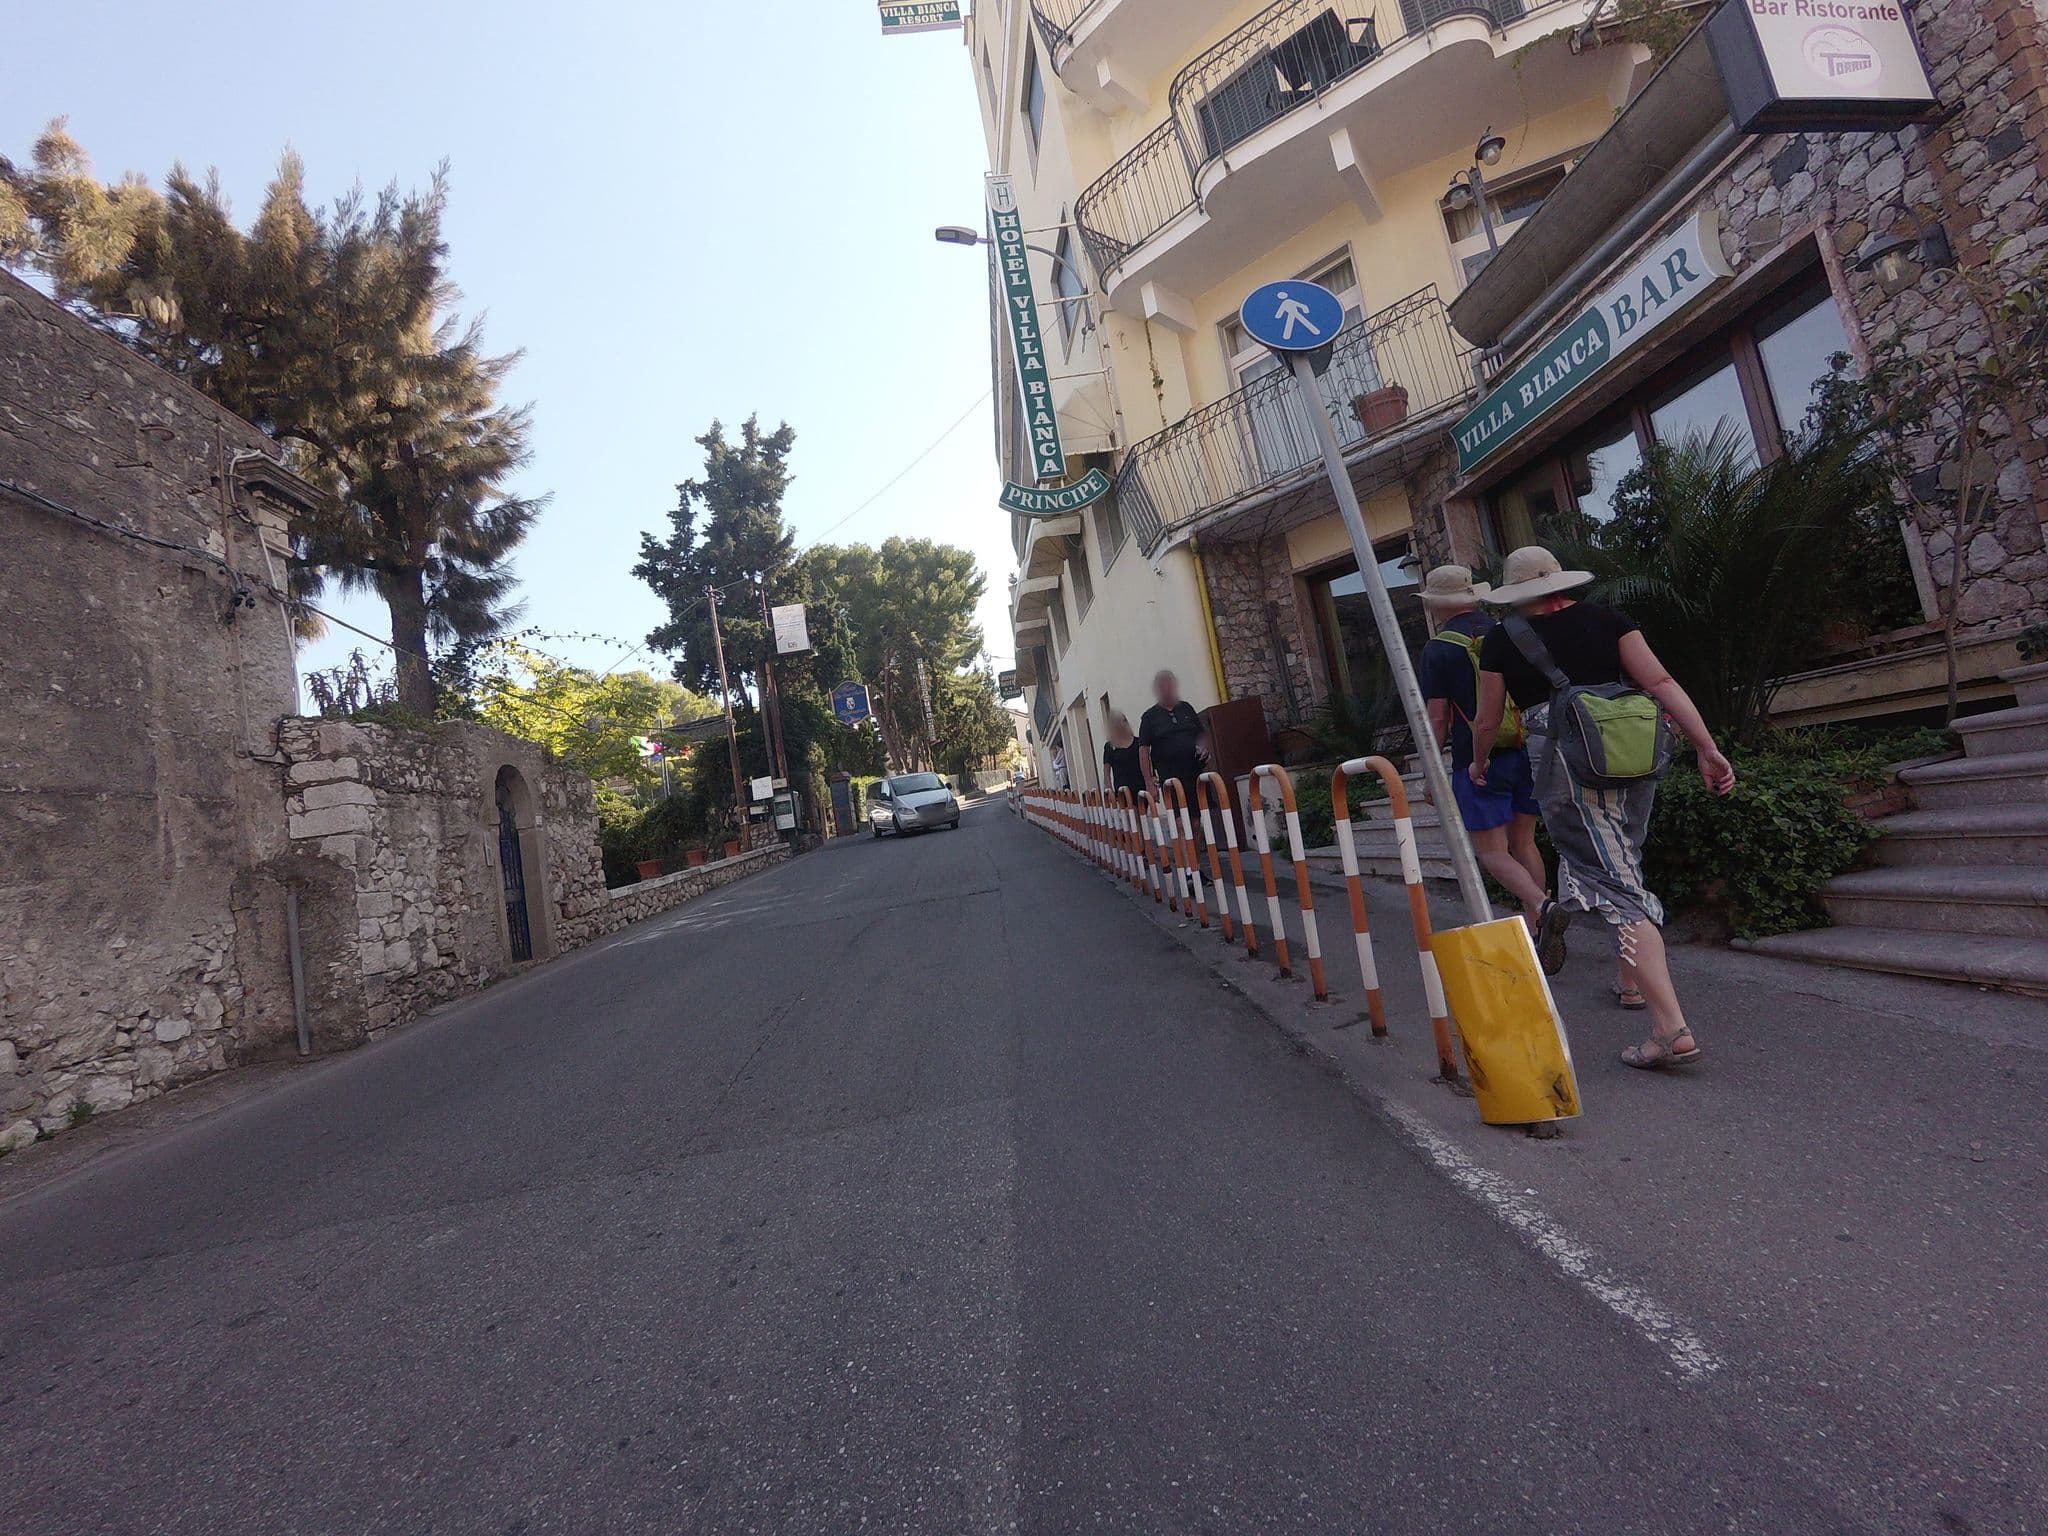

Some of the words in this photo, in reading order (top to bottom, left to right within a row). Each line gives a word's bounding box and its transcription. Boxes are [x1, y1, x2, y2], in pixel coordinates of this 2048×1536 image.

[882, 7, 915, 17] VILLA
[917, 2, 957, 15] BIANCA
[898, 13, 944, 25] RESORT
[1752, 0, 1788, 15] Bar
[1796, 0, 1898, 21] Ristorante
[997, 215, 1027, 285] HOTEL
[1012, 296, 1042, 370] VILLA
[1029, 382, 1060, 474] BIANCA
[1459, 402, 1514, 453] VILLA
[1518, 327, 1604, 409] BIANCA
[1610, 247, 1700, 339] BAR
[1007, 476, 1102, 510] PRINCIPE
